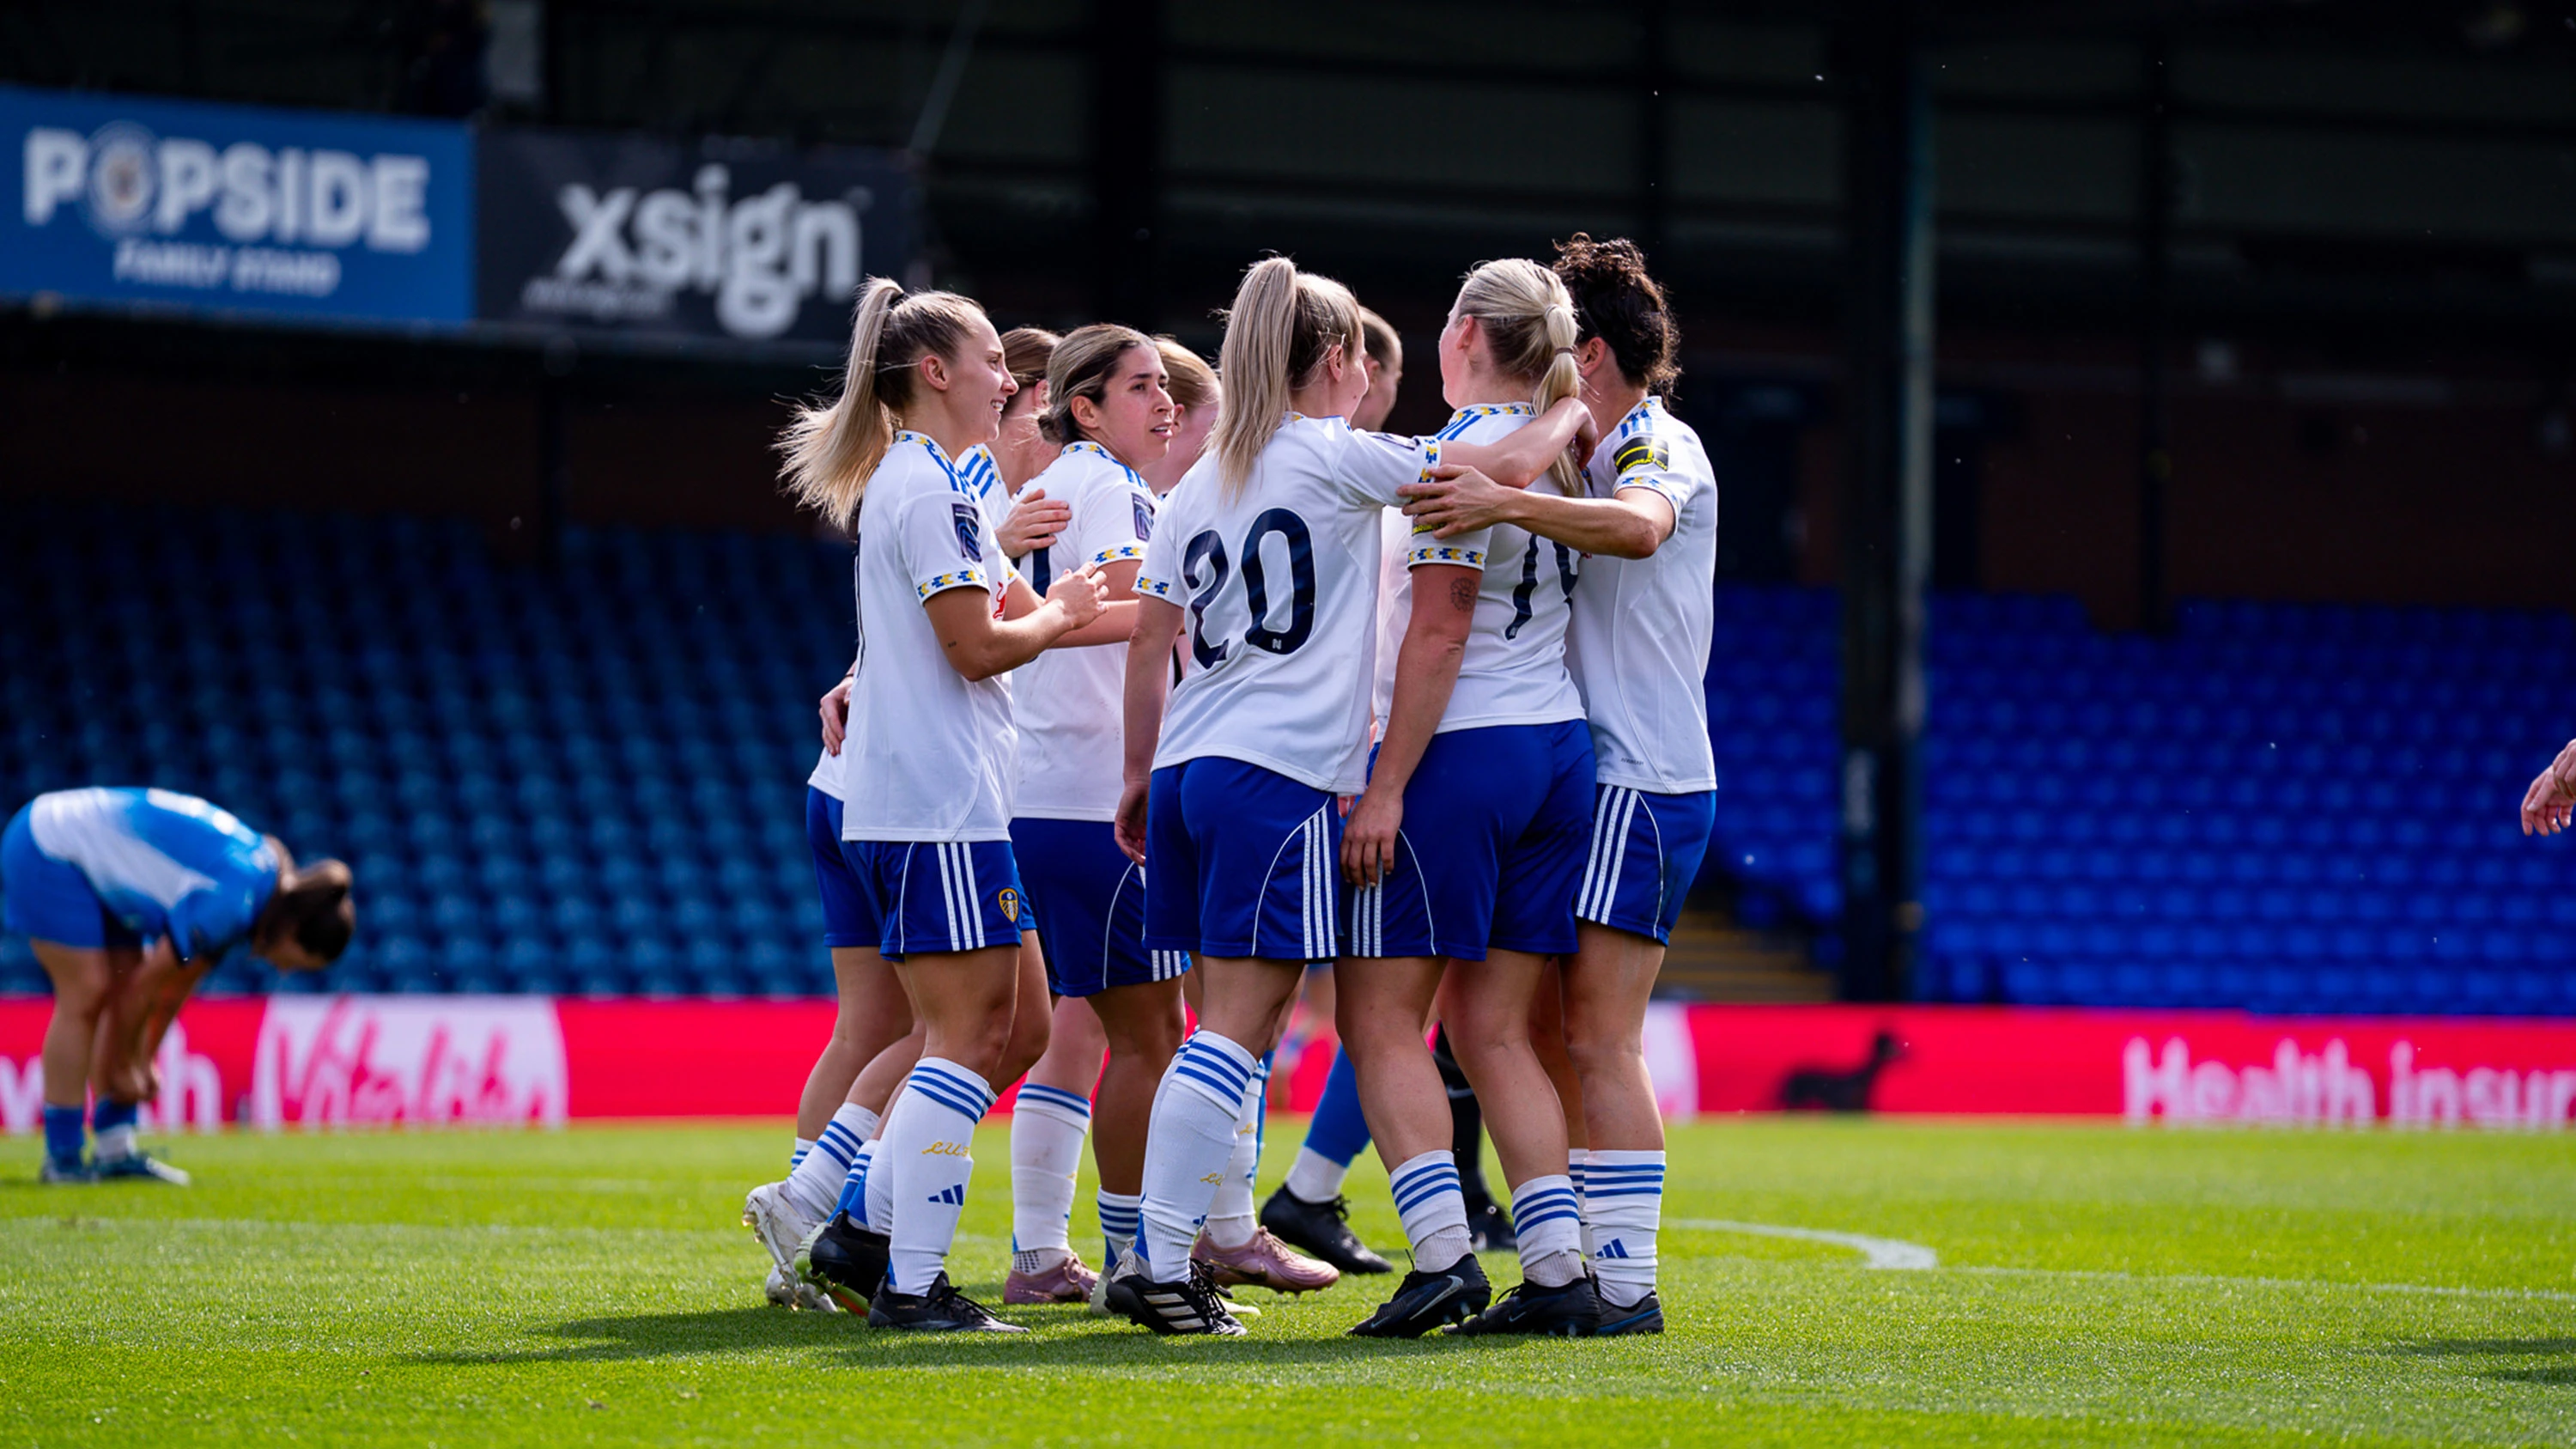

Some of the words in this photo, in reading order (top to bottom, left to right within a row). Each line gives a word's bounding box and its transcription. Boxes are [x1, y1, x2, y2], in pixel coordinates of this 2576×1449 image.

[23, 126, 429, 253] POPSIDE
[557, 164, 861, 338] xsign
[1182, 507, 1316, 669] 20
[2123, 1037, 2376, 1130] Health
